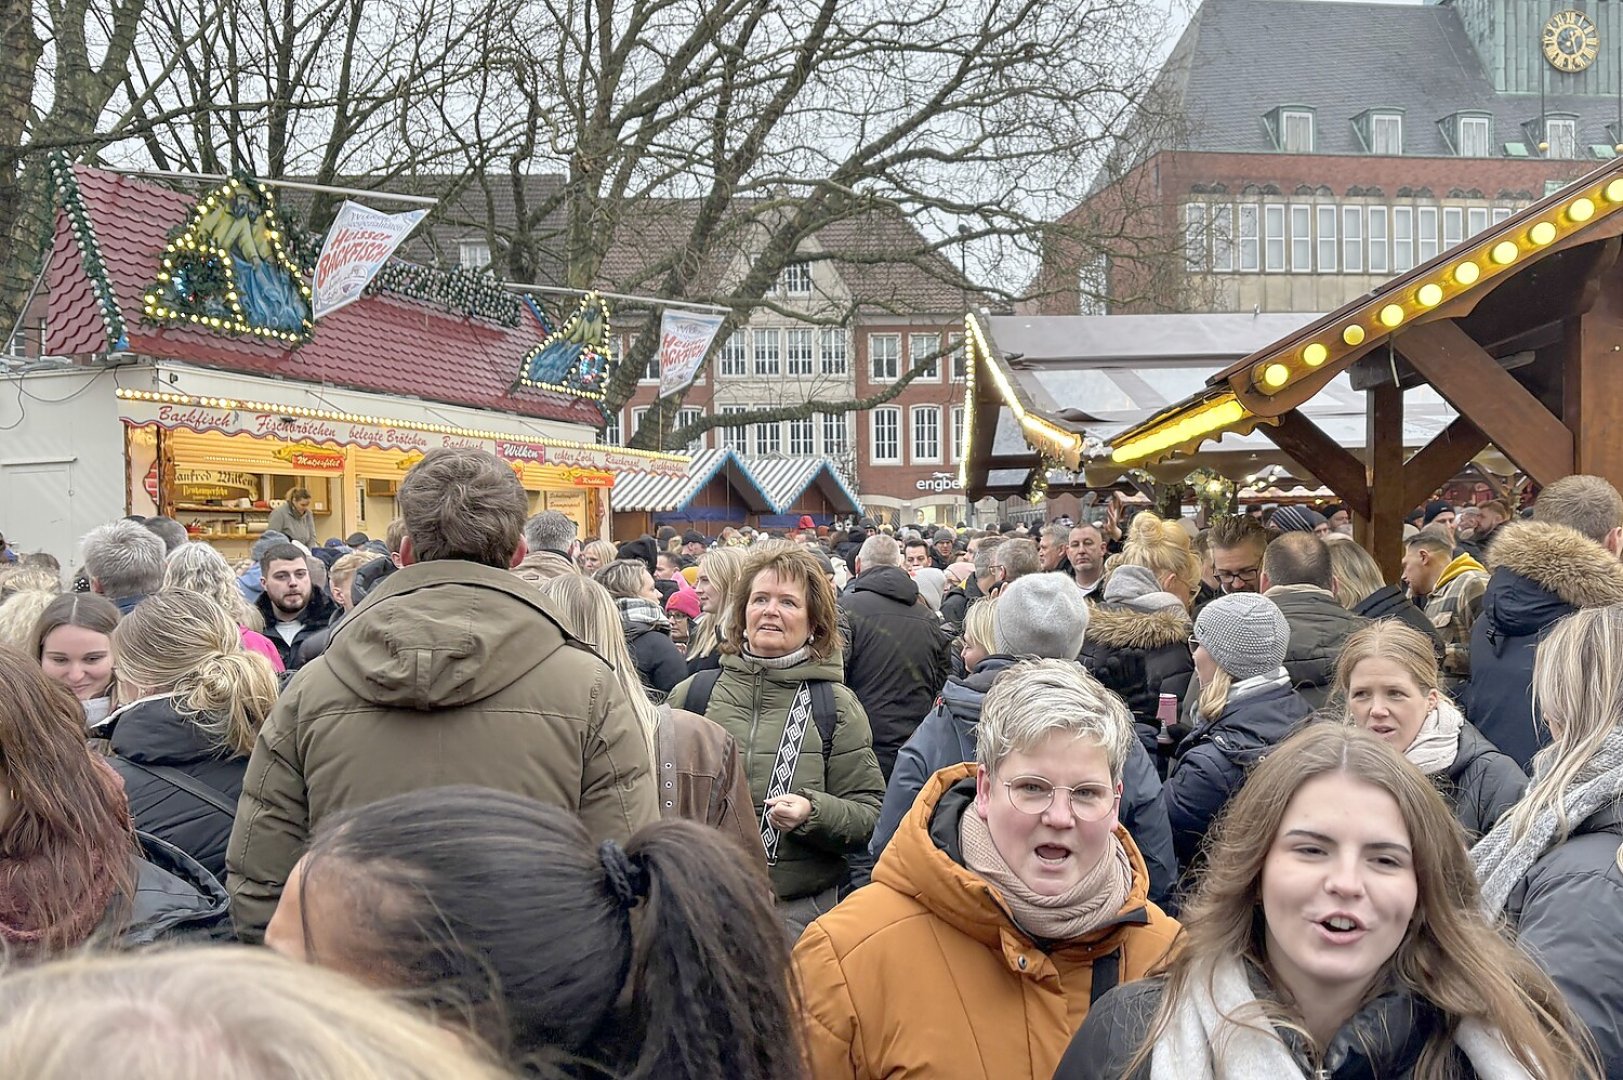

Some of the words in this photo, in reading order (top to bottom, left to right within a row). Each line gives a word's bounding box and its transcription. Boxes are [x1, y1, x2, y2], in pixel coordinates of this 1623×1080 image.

[317, 242, 392, 289] BACKFISCH
[158, 405, 231, 428] Backfisch
[255, 413, 337, 438] Fischbrötchen
[348, 425, 384, 444] belegte
[386, 428, 428, 447] Brötchen
[502, 443, 540, 459] Wilken
[915, 476, 960, 492] engbe
